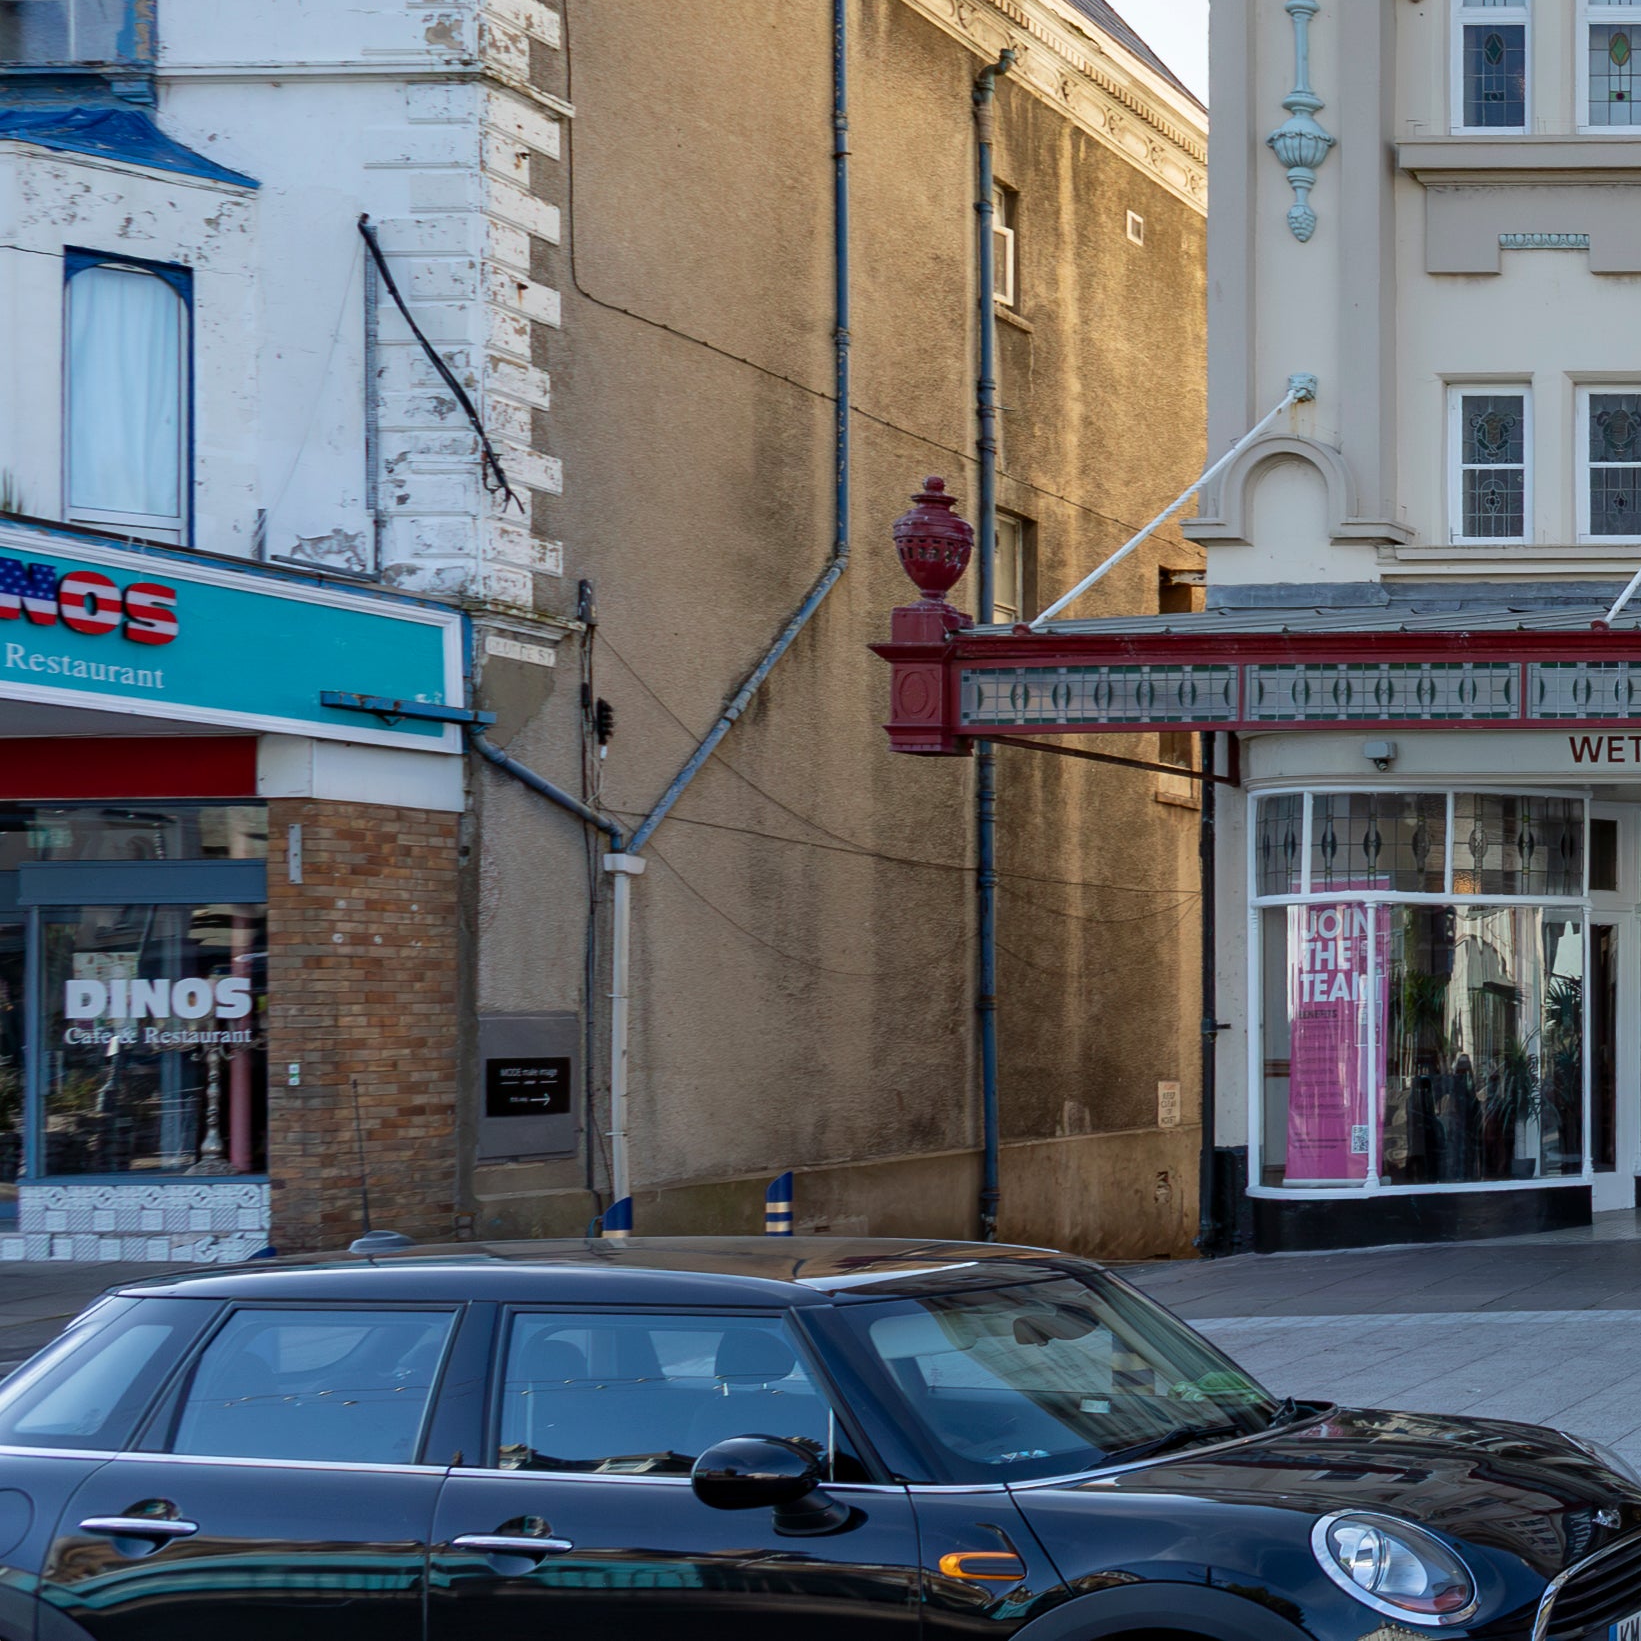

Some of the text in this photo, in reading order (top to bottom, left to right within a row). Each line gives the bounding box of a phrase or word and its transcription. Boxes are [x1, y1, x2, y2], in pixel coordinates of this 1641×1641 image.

[5, 642, 165, 689] Restaurant
[1306, 908, 1368, 939] JOIN
[1301, 940, 1351, 971] THE
[65, 977, 252, 1019] DINOS
[65, 1027, 110, 1045] Cafe
[144, 1027, 252, 1045] Restaurant
